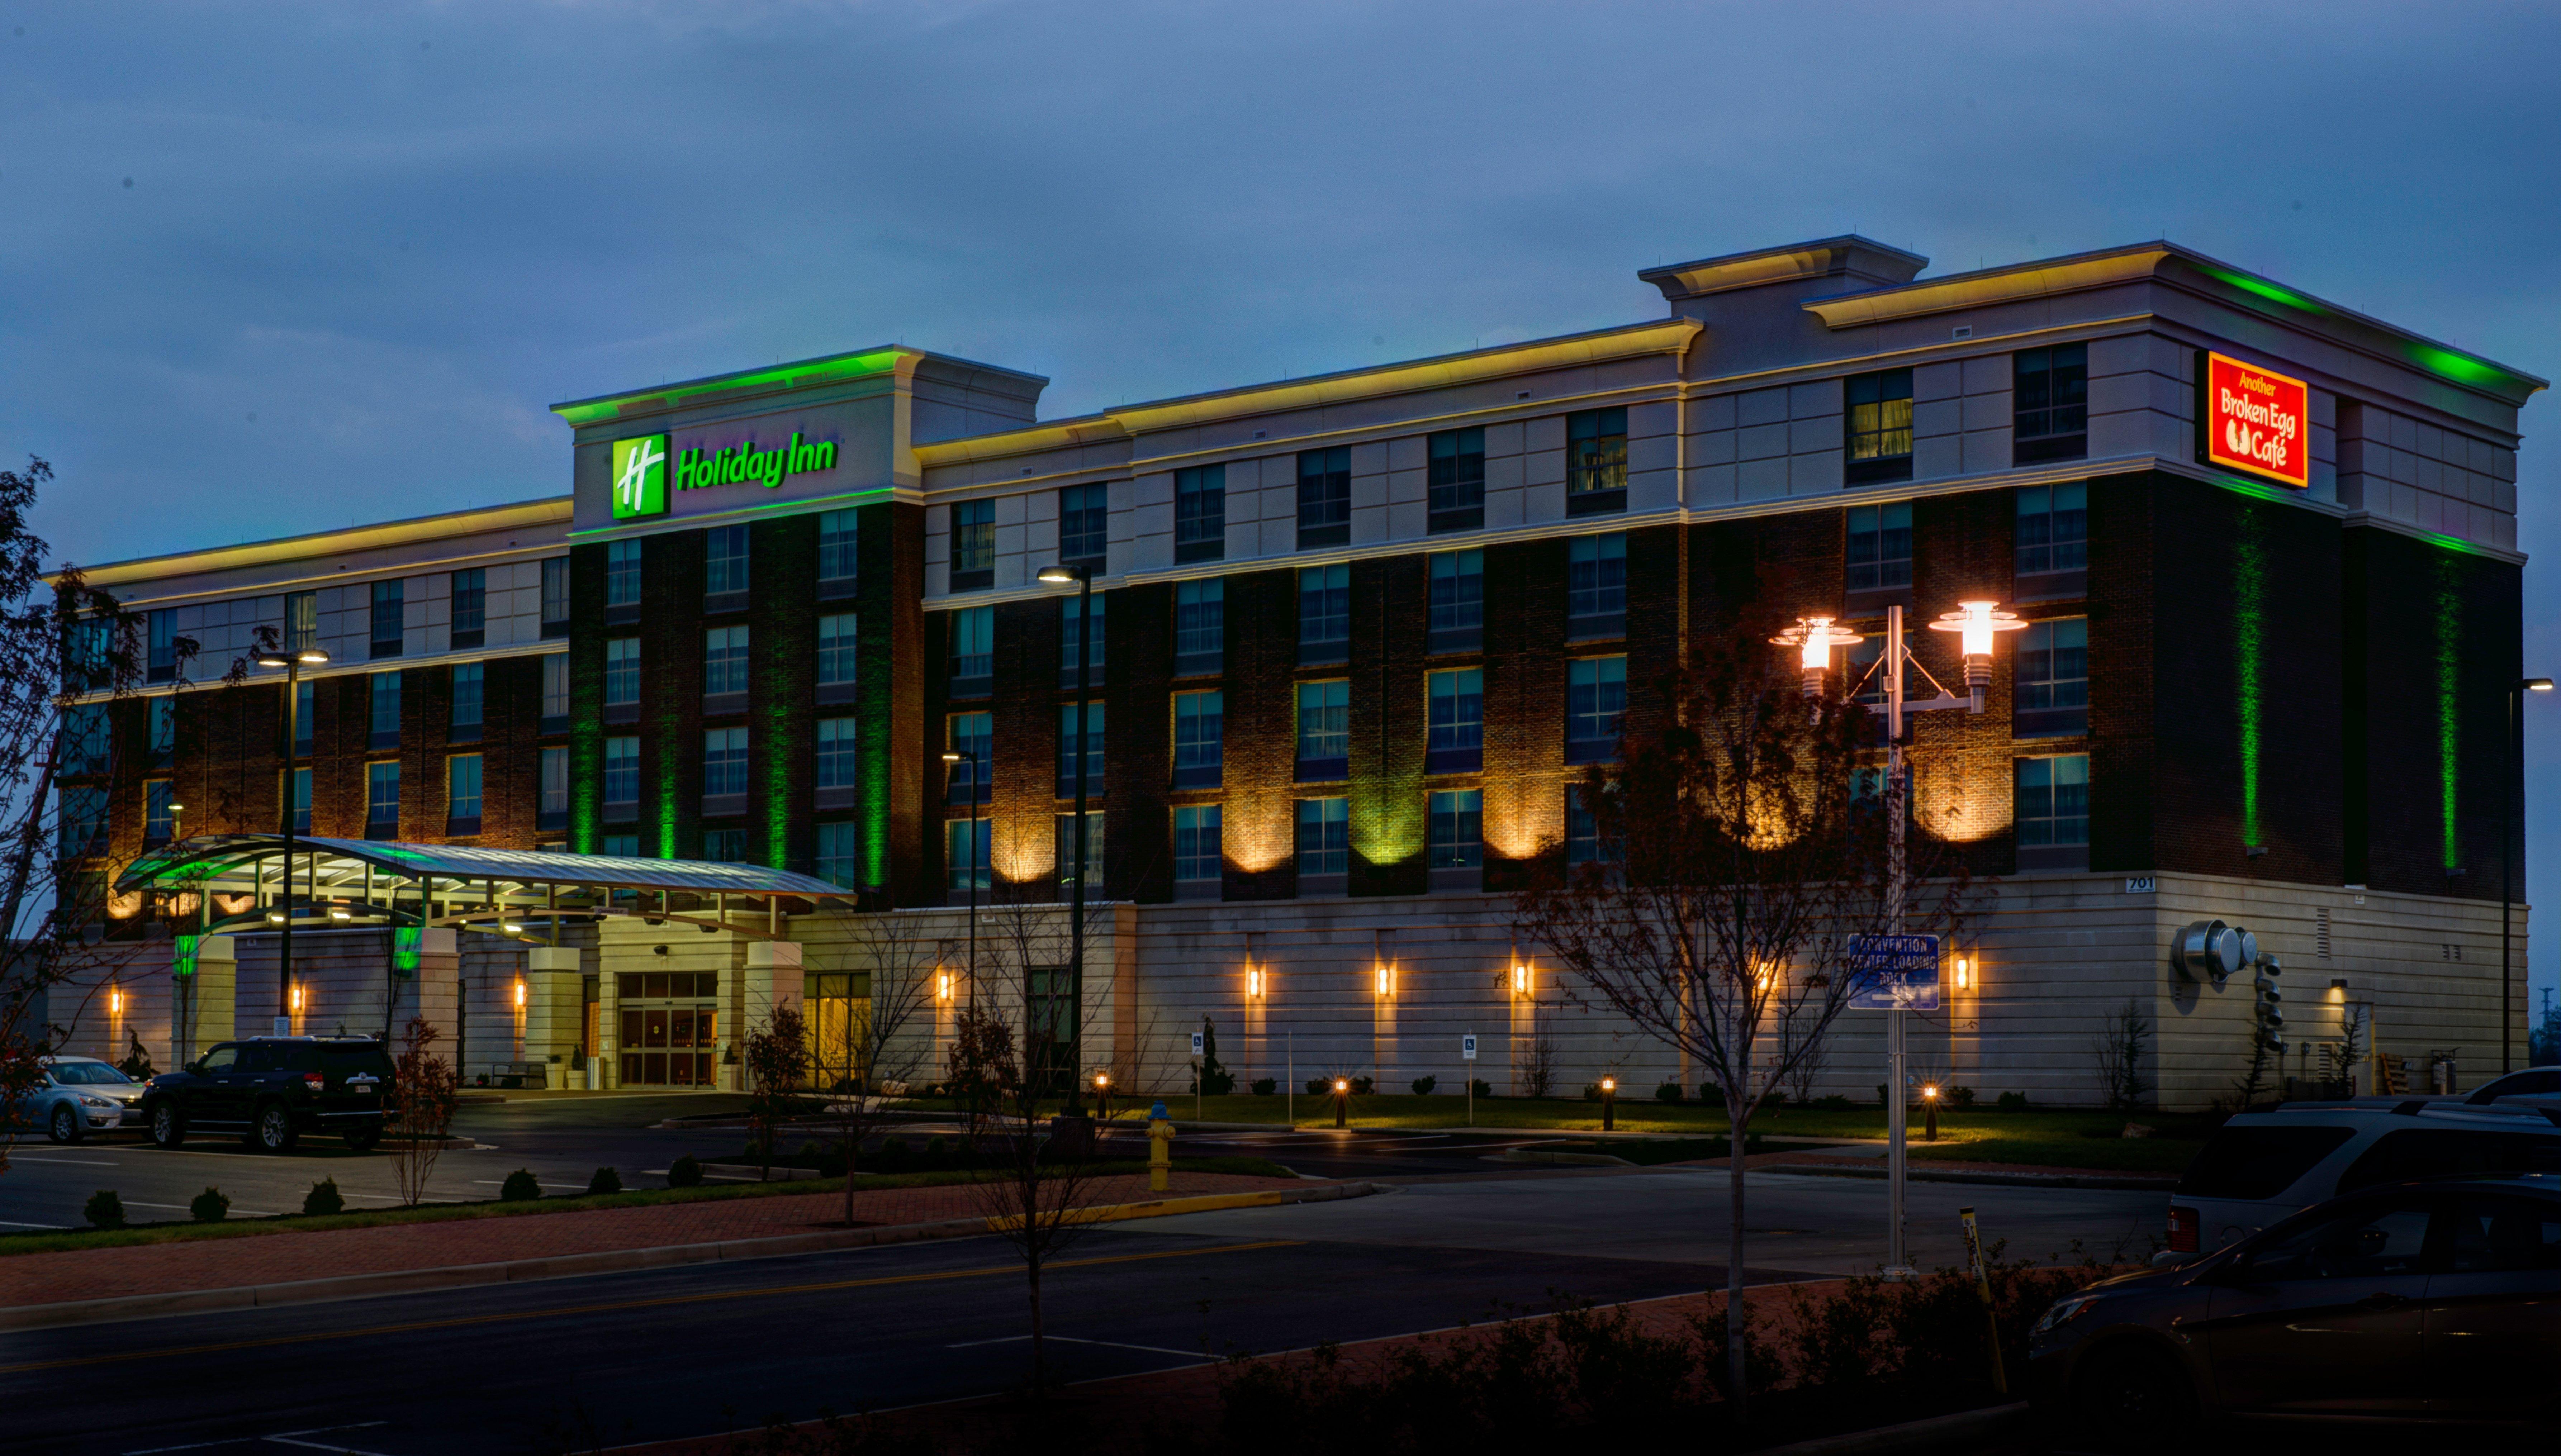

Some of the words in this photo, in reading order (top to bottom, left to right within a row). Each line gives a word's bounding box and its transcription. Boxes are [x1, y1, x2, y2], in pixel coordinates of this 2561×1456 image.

[2239, 371, 2276, 397] Another
[2221, 387, 2268, 427] Broken
[2270, 402, 2296, 439] Egg
[675, 441, 786, 489] Holiday
[787, 432, 836, 474] Inn
[2252, 431, 2287, 469] Café
[2129, 877, 2153, 889] 701
[1893, 956, 1936, 970] LOADING
